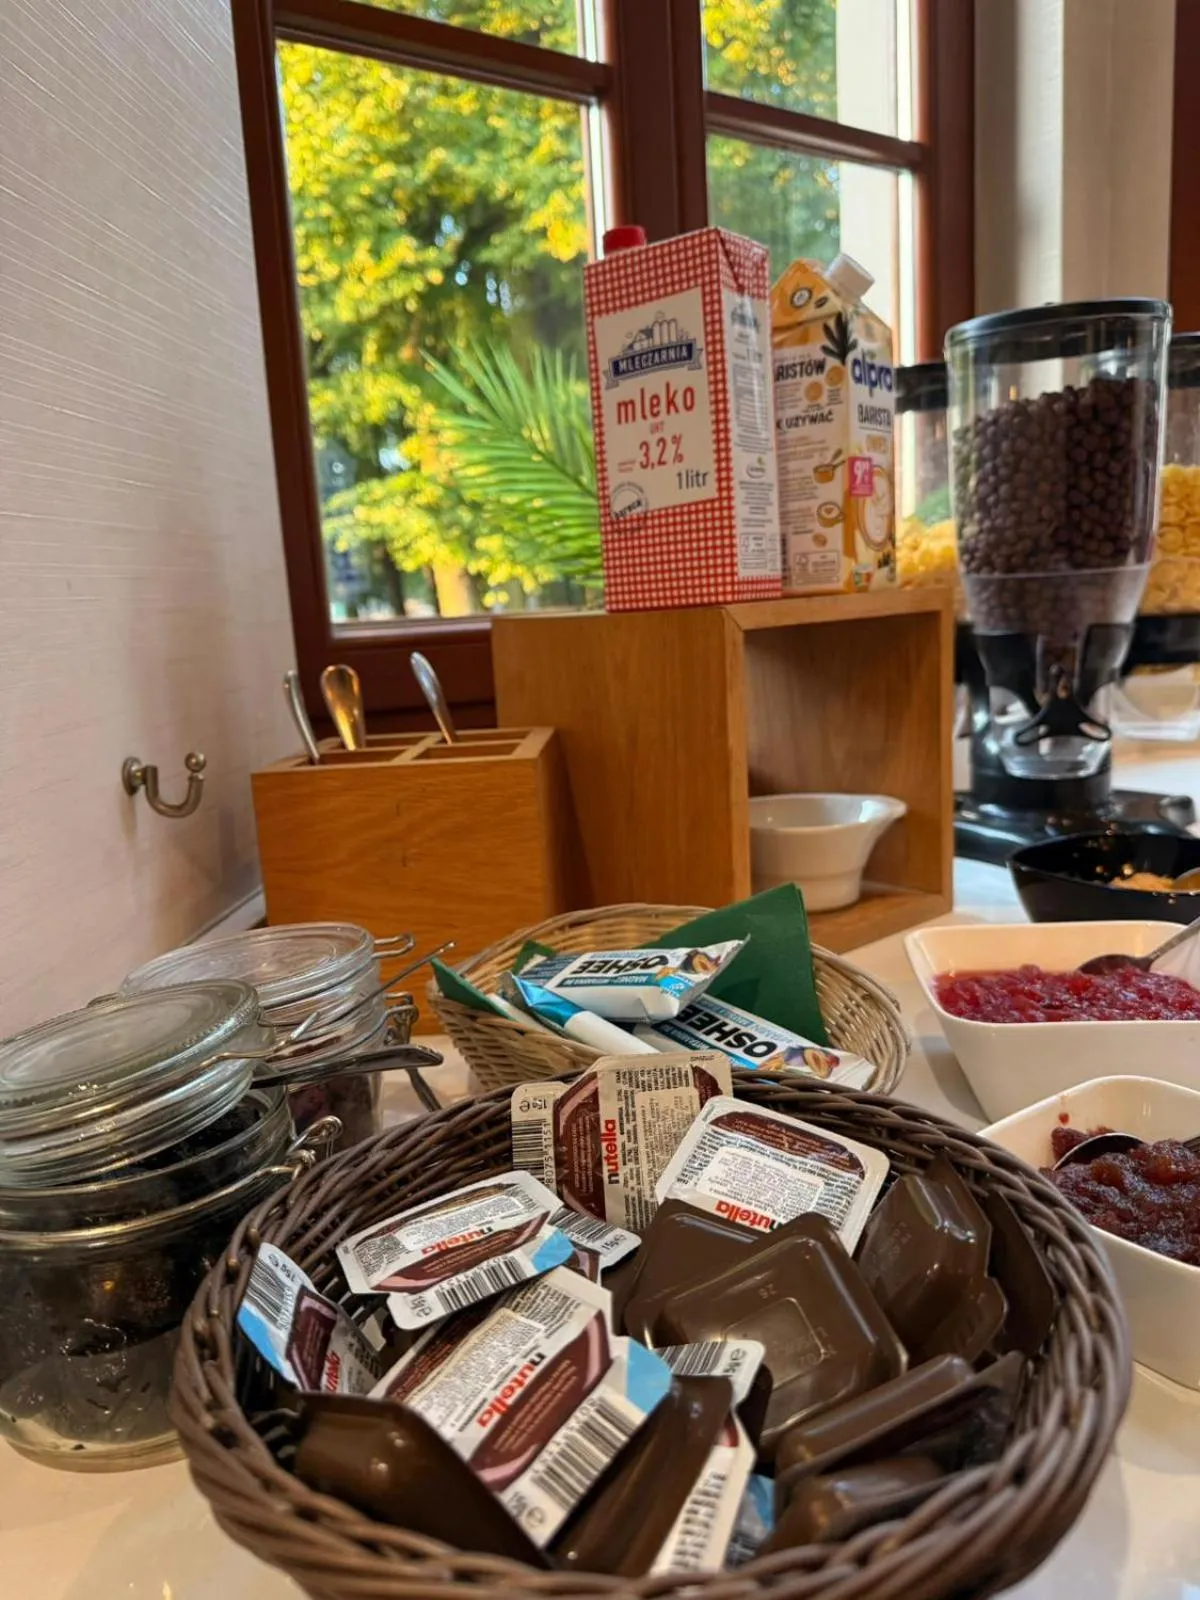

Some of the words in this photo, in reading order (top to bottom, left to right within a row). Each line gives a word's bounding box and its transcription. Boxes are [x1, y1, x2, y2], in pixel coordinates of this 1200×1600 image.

[619, 345, 689, 372] MLECZARNIA
[852, 348, 893, 398] alpro
[617, 381, 695, 425] mleko
[685, 469, 709, 489] litr
[570, 954, 669, 975] OSHEE
[674, 1003, 778, 1058] OSHEE
[600, 1118, 620, 1185] nutella
[421, 1225, 493, 1256] nutella
[475, 1352, 546, 1429] nutella
